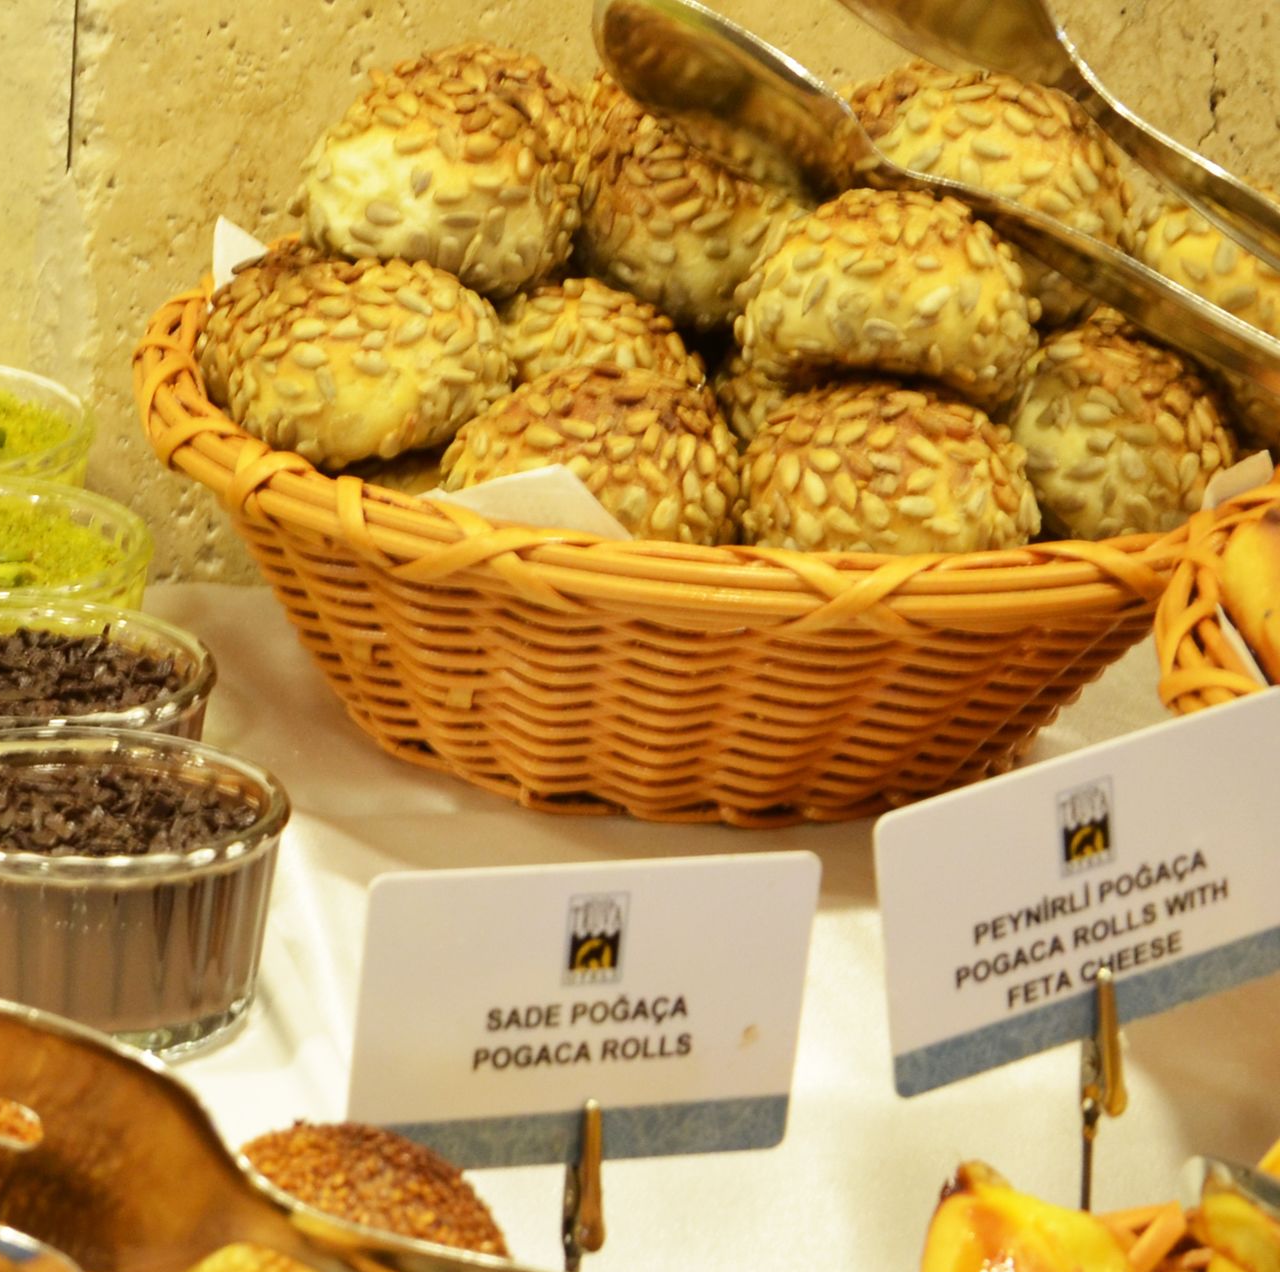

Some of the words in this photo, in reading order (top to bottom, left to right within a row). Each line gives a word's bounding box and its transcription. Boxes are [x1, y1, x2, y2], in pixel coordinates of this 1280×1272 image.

[955, 937, 1064, 990] POGACA
[1073, 903, 1157, 951] ROLLS
[1165, 878, 1229, 919] WITH
[973, 886, 1090, 946] PEYNİRLİ
[1098, 849, 1206, 904] POĞAÇA
[1006, 969, 1072, 1009] FETA
[1080, 931, 1183, 984] CHEESE
[486, 1003, 560, 1032] SADE
[571, 994, 688, 1025] POĞAÇA
[472, 1041, 590, 1072] POGACA
[601, 1033, 693, 1062] ROLLS
